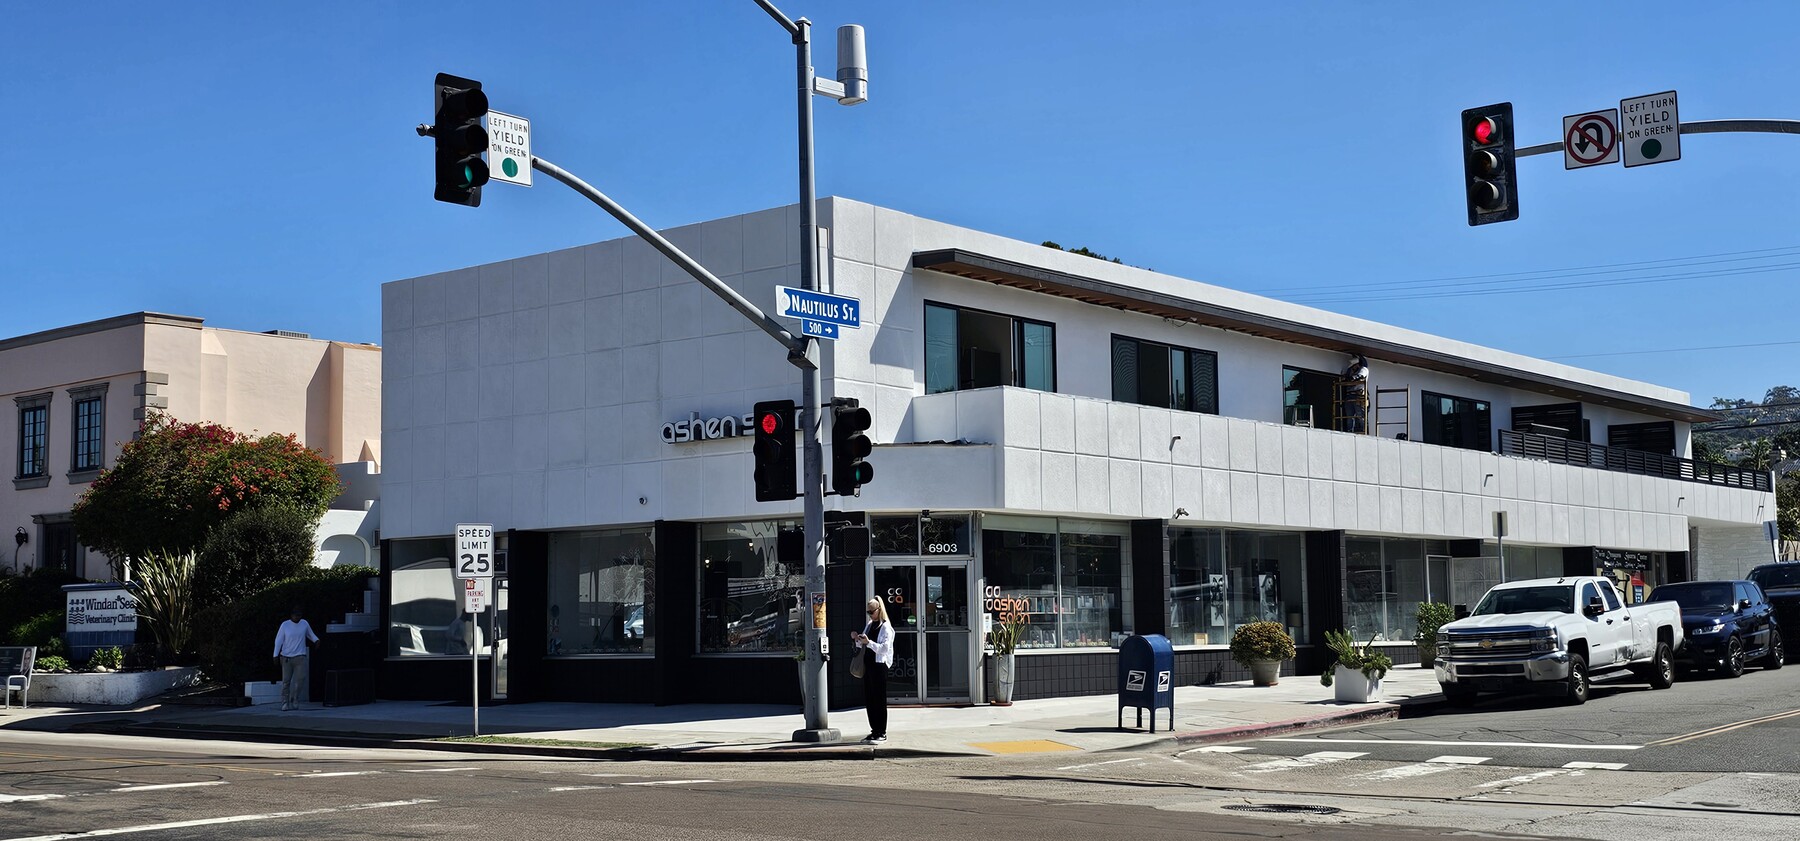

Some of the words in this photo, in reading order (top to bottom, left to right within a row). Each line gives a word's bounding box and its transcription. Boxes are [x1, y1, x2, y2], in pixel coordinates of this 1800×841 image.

[1623, 103, 1646, 114] LEFT
[1650, 97, 1675, 109] TURN
[489, 116, 507, 129] LEFT
[509, 121, 528, 134] TURN
[1629, 110, 1670, 127] YIELD
[493, 129, 524, 146] YIELD
[1629, 130, 1640, 139] ON
[1644, 124, 1671, 137] GREEN
[492, 143, 502, 153] ON
[504, 146, 527, 159] GREEN
[808, 321, 822, 335] 500
[660, 411, 737, 444] ashen
[458, 528, 491, 538] SPEED
[461, 541, 488, 550] LIMIT
[928, 543, 958, 553] 6903
[460, 553, 490, 573] 25
[85, 597, 118, 611] Windan
[119, 596, 137, 610] Sea
[993, 593, 1030, 611] ashen
[85, 614, 118, 626] Veterinary
[118, 613, 136, 623] Clinic
